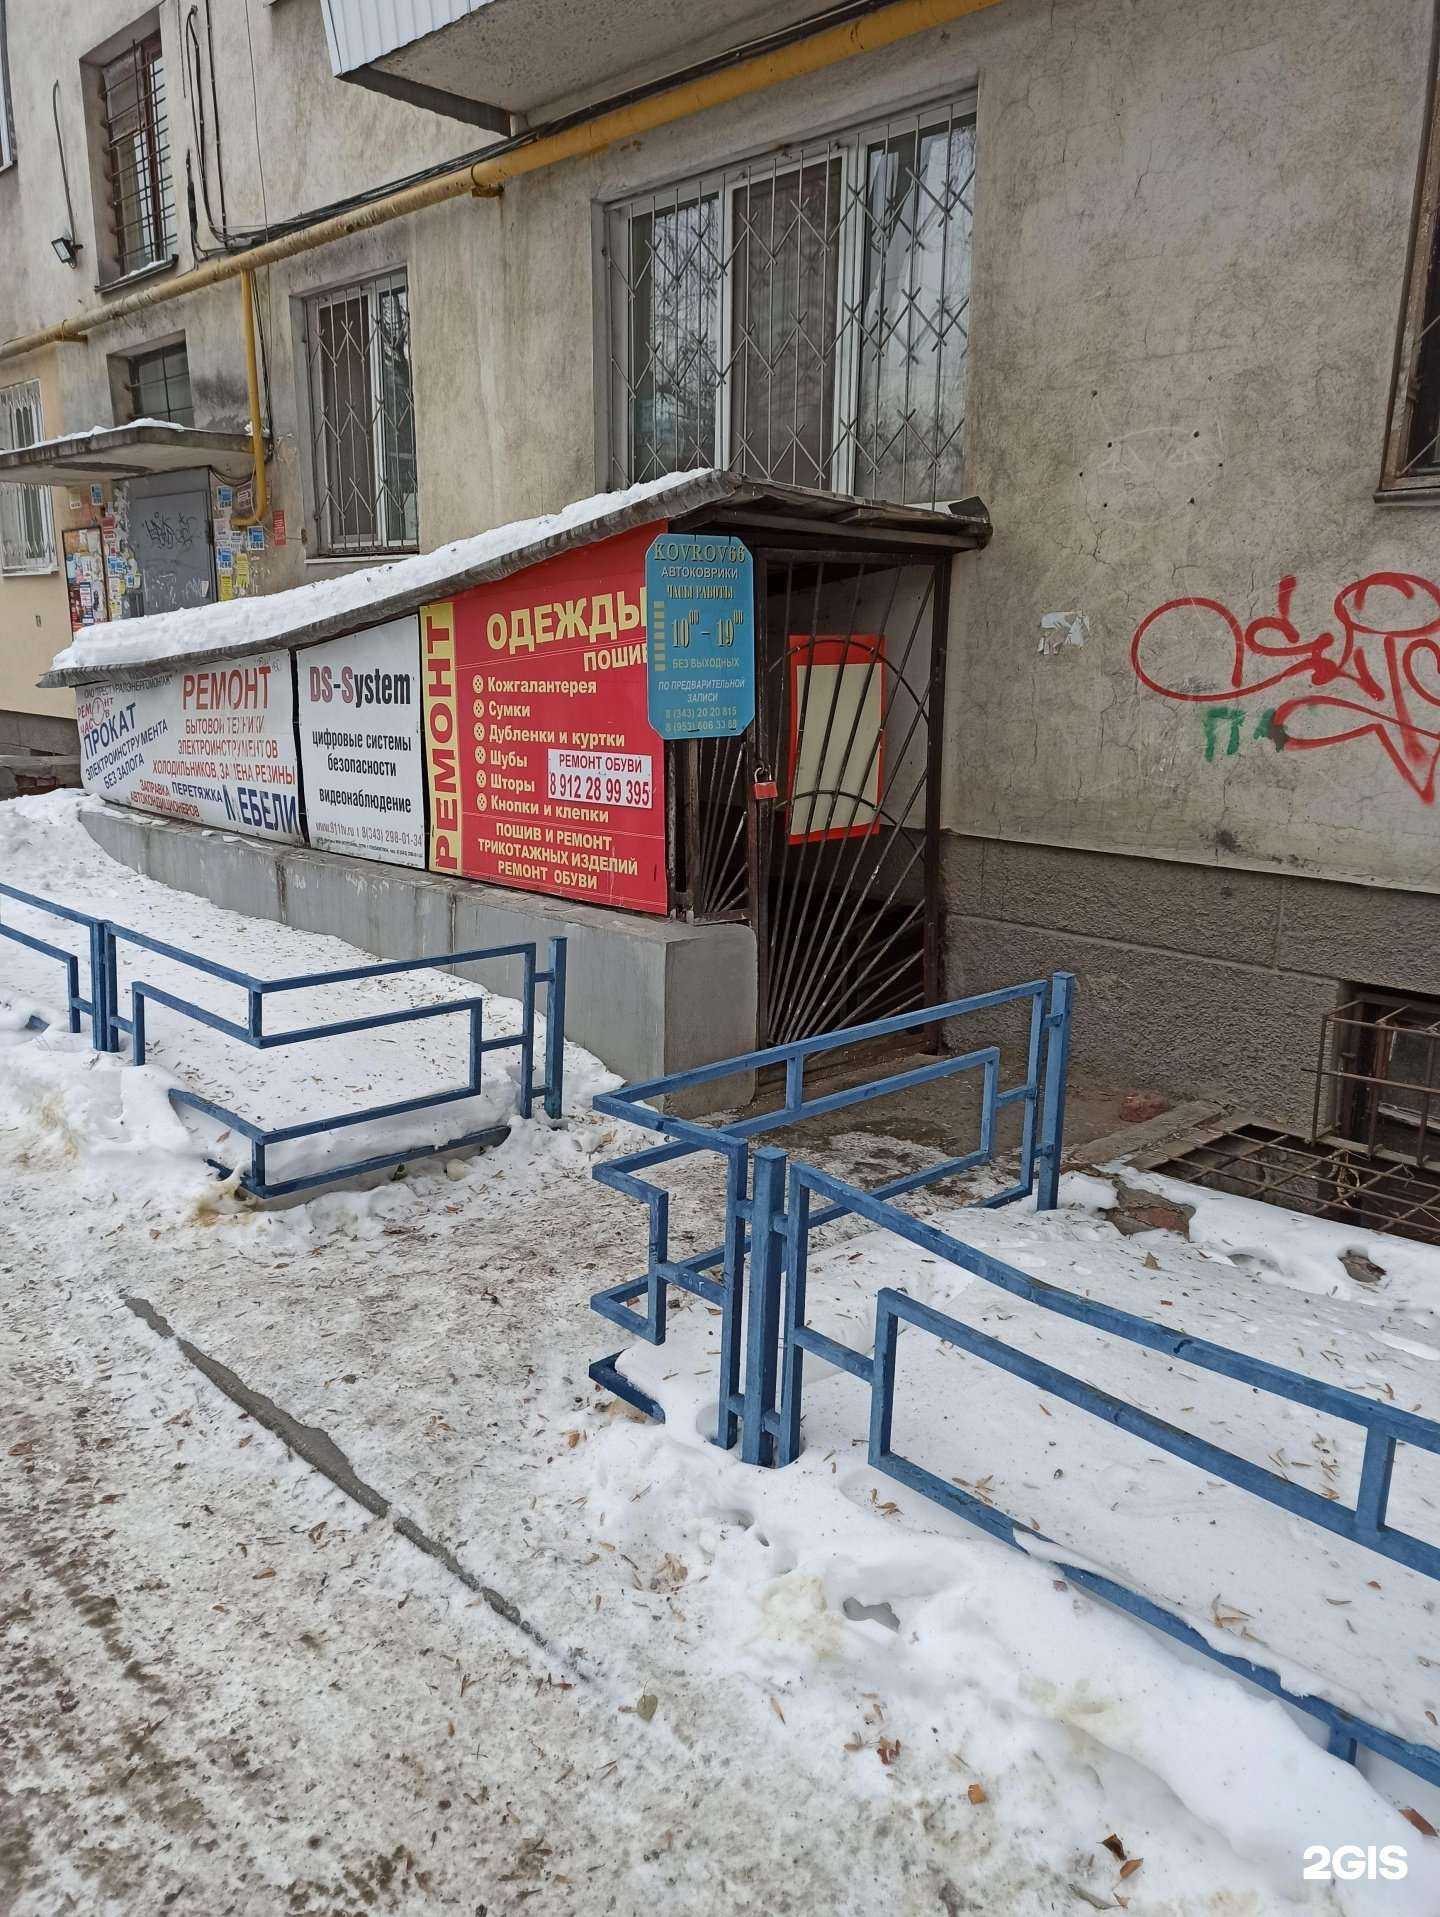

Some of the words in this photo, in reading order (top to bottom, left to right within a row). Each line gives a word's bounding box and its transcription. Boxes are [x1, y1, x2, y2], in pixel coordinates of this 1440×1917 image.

[661, 567, 738, 579] АВТОКОВРИКИ
[486, 587, 648, 654] ОДЕЖДЫ
[672, 658, 688, 669] БЕЗ
[691, 657, 740, 669] ВЫХОДНЫХ
[182, 665, 272, 710] РЕМОНТ
[309, 665, 411, 708] DS-System
[487, 676, 597, 697] Кожгалантерея
[658, 681, 670, 690] ПО
[672, 677, 745, 690] ПРЕДВАРИТЕЛЬНОЙ
[687, 692, 718, 702] ЗАПИСИ
[488, 700, 531, 719] Сумки
[697, 708, 708, 717] 20
[709, 707, 720, 717] 20
[83, 702, 136, 760] ПРОКАТ
[312, 728, 363, 752] цифровые
[366, 733, 411, 751] системы
[426, 616, 457, 870] РЕМОНТ
[489, 724, 555, 745] Дубленки
[559, 730, 567, 743] и
[572, 731, 625, 749] куртки
[86, 719, 168, 781] ЭЛЕКТРОИНСТРУМЕНТА
[490, 751, 528, 771] Шубы
[103, 770, 117, 789] БЕЗ
[117, 753, 145, 780] ЗАЛОГА
[255, 764, 296, 785] РЕЗИНЫ
[328, 753, 397, 776] безопасности
[559, 753, 602, 769] РЕМОНТ
[605, 757, 642, 773] ОБУВИ
[139, 779, 169, 796] ЗАПРАВКА
[172, 782, 223, 802] ПЕРЕТЯЖКА
[490, 774, 535, 794] Шторы
[550, 772, 557, 796] 8
[560, 773, 581, 798] 912
[585, 776, 601, 800] 28
[605, 778, 622, 803] 99
[625, 781, 649, 806] 395
[319, 787, 411, 814] видеонаблюдение
[490, 795, 539, 815] Кнопки
[543, 803, 551, 816] и
[555, 806, 609, 823] клепки
[496, 822, 542, 842] ПОШИВ
[545, 829, 554, 842] И
[557, 831, 612, 851] РЕМОНТ
[478, 838, 569, 866] ТРИКОТАЖНЫХ
[572, 852, 638, 876] ИЗДЕЛИЙ
[498, 861, 548, 881] РЕМОНТ
[553, 870, 597, 889] ОБУВИ
